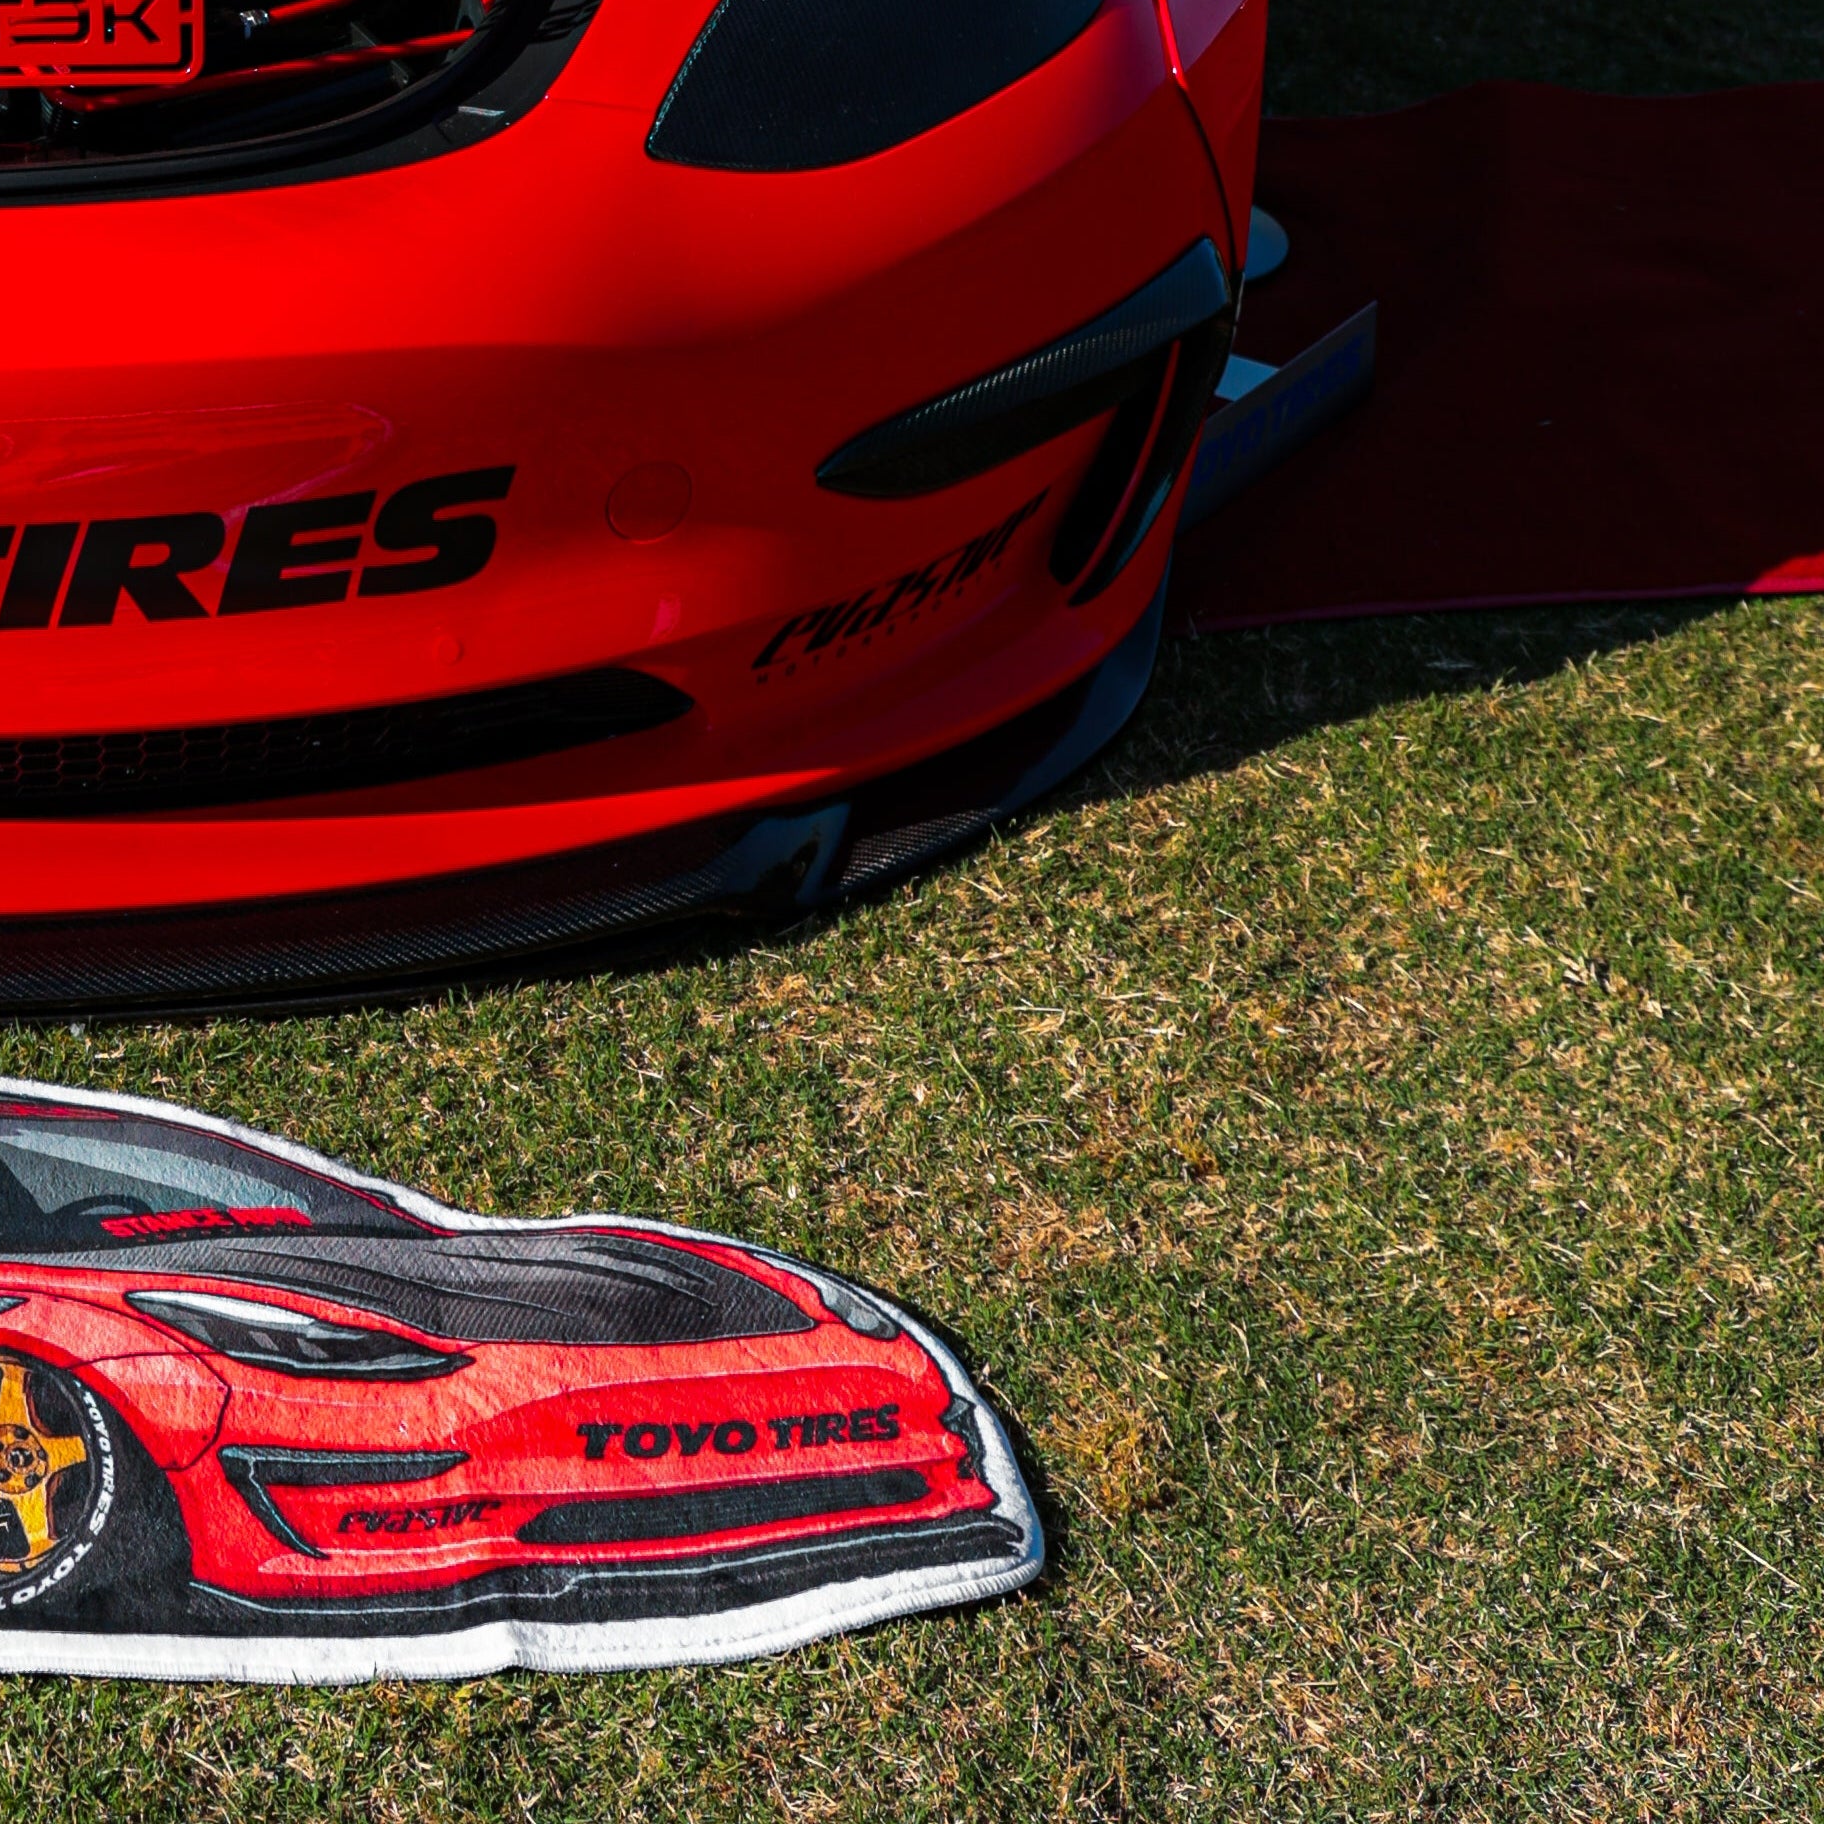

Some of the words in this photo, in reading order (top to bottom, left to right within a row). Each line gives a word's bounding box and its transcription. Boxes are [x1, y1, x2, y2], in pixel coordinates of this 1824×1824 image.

[576, 1419, 758, 1460] TOYO
[767, 1403, 900, 1450] TIRES
[11, 1541, 94, 1605] TOYO
